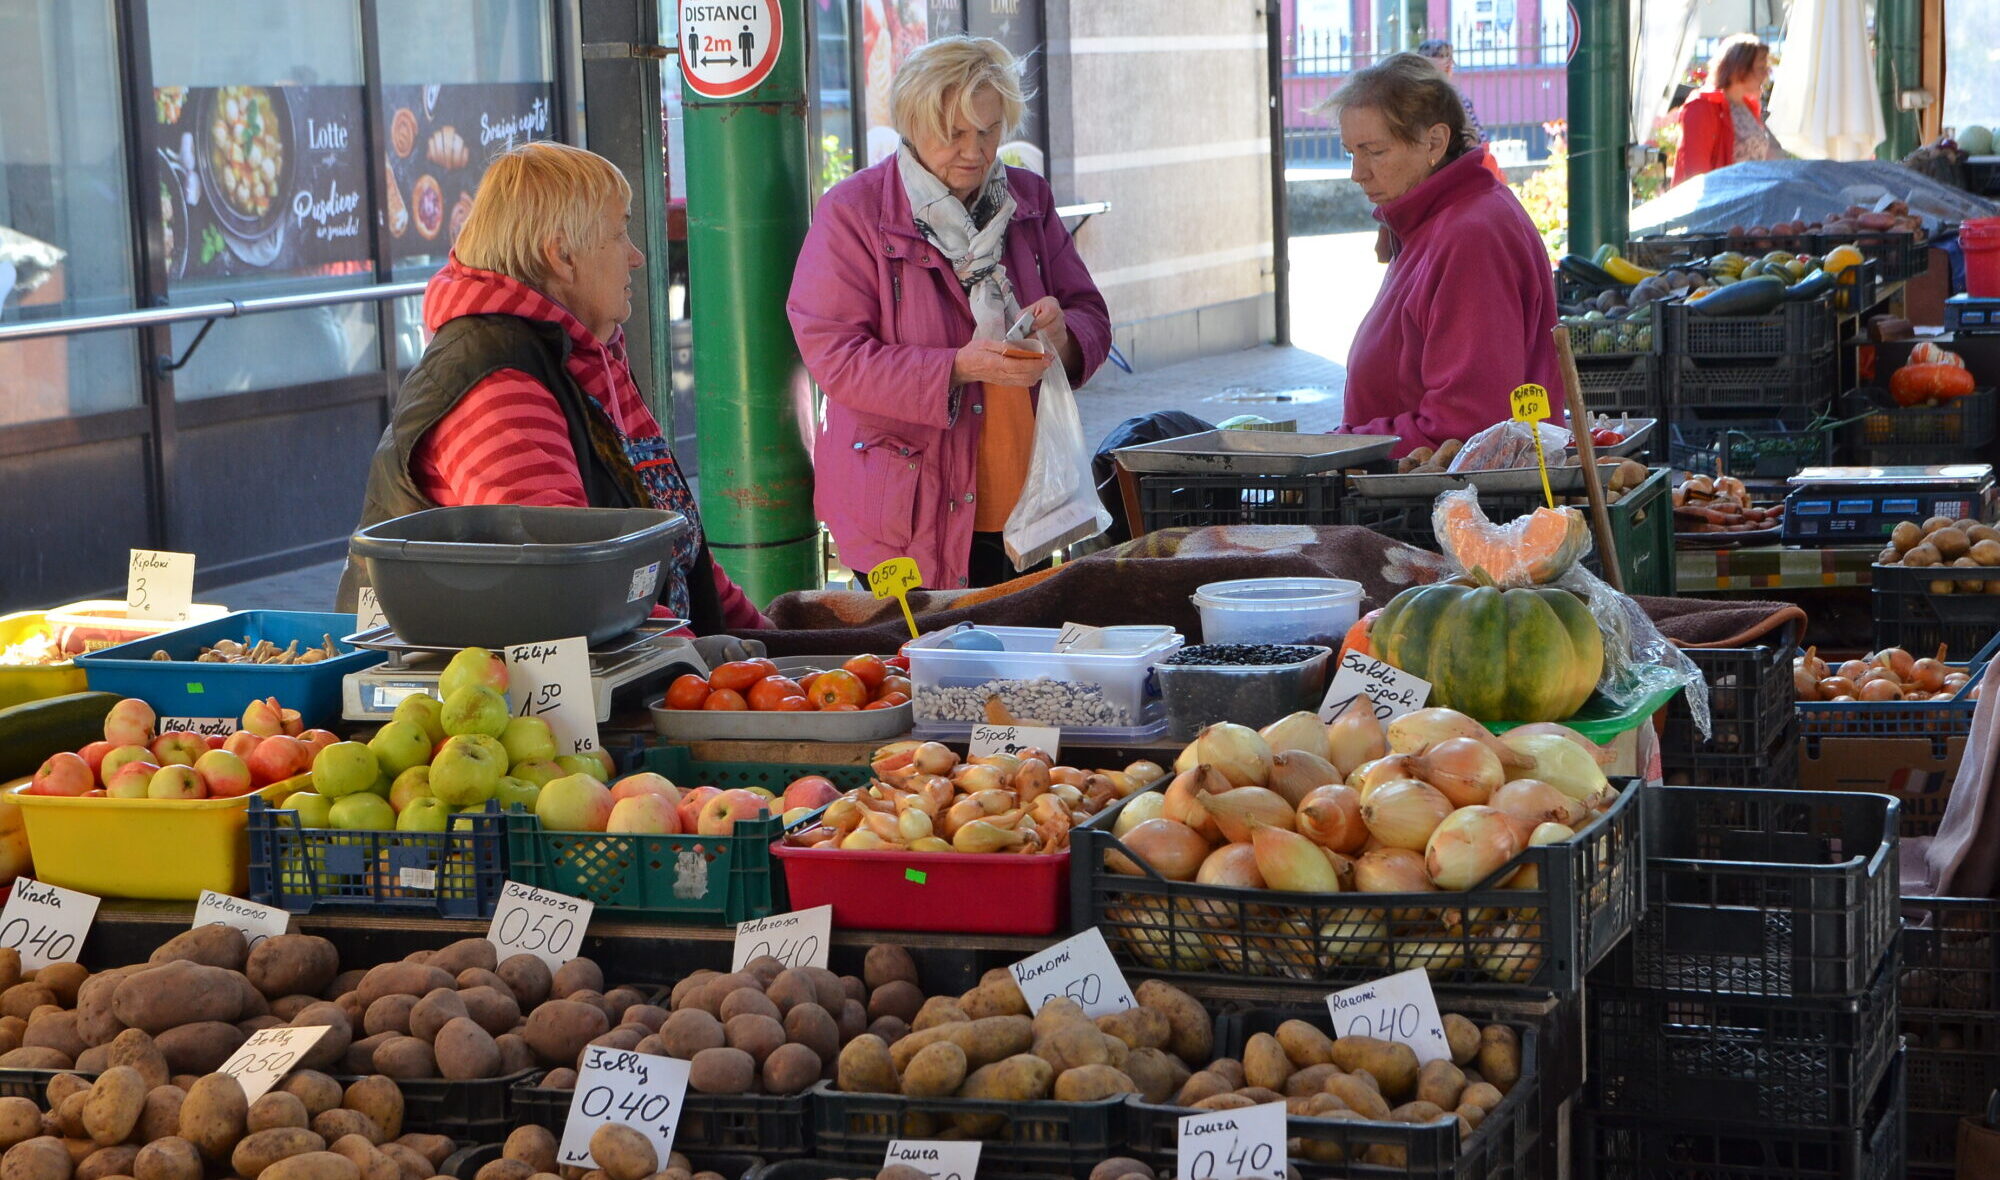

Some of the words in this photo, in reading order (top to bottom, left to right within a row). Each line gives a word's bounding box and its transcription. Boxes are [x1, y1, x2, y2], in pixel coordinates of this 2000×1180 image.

[685, 5, 757, 22] DISTANCI
[703, 35, 732, 52] 2m
[307, 118, 348, 149] Lotte
[1518, 402, 1538, 417] 1.50
[871, 564, 897, 585] 0.50
[129, 577, 147, 608] 3
[573, 738, 593, 753] KG
[17, 880, 61, 909] Vineta
[499, 907, 574, 954] 0.50
[585, 1048, 649, 1086] Jelly
[581, 1085, 671, 1122] 0.40
